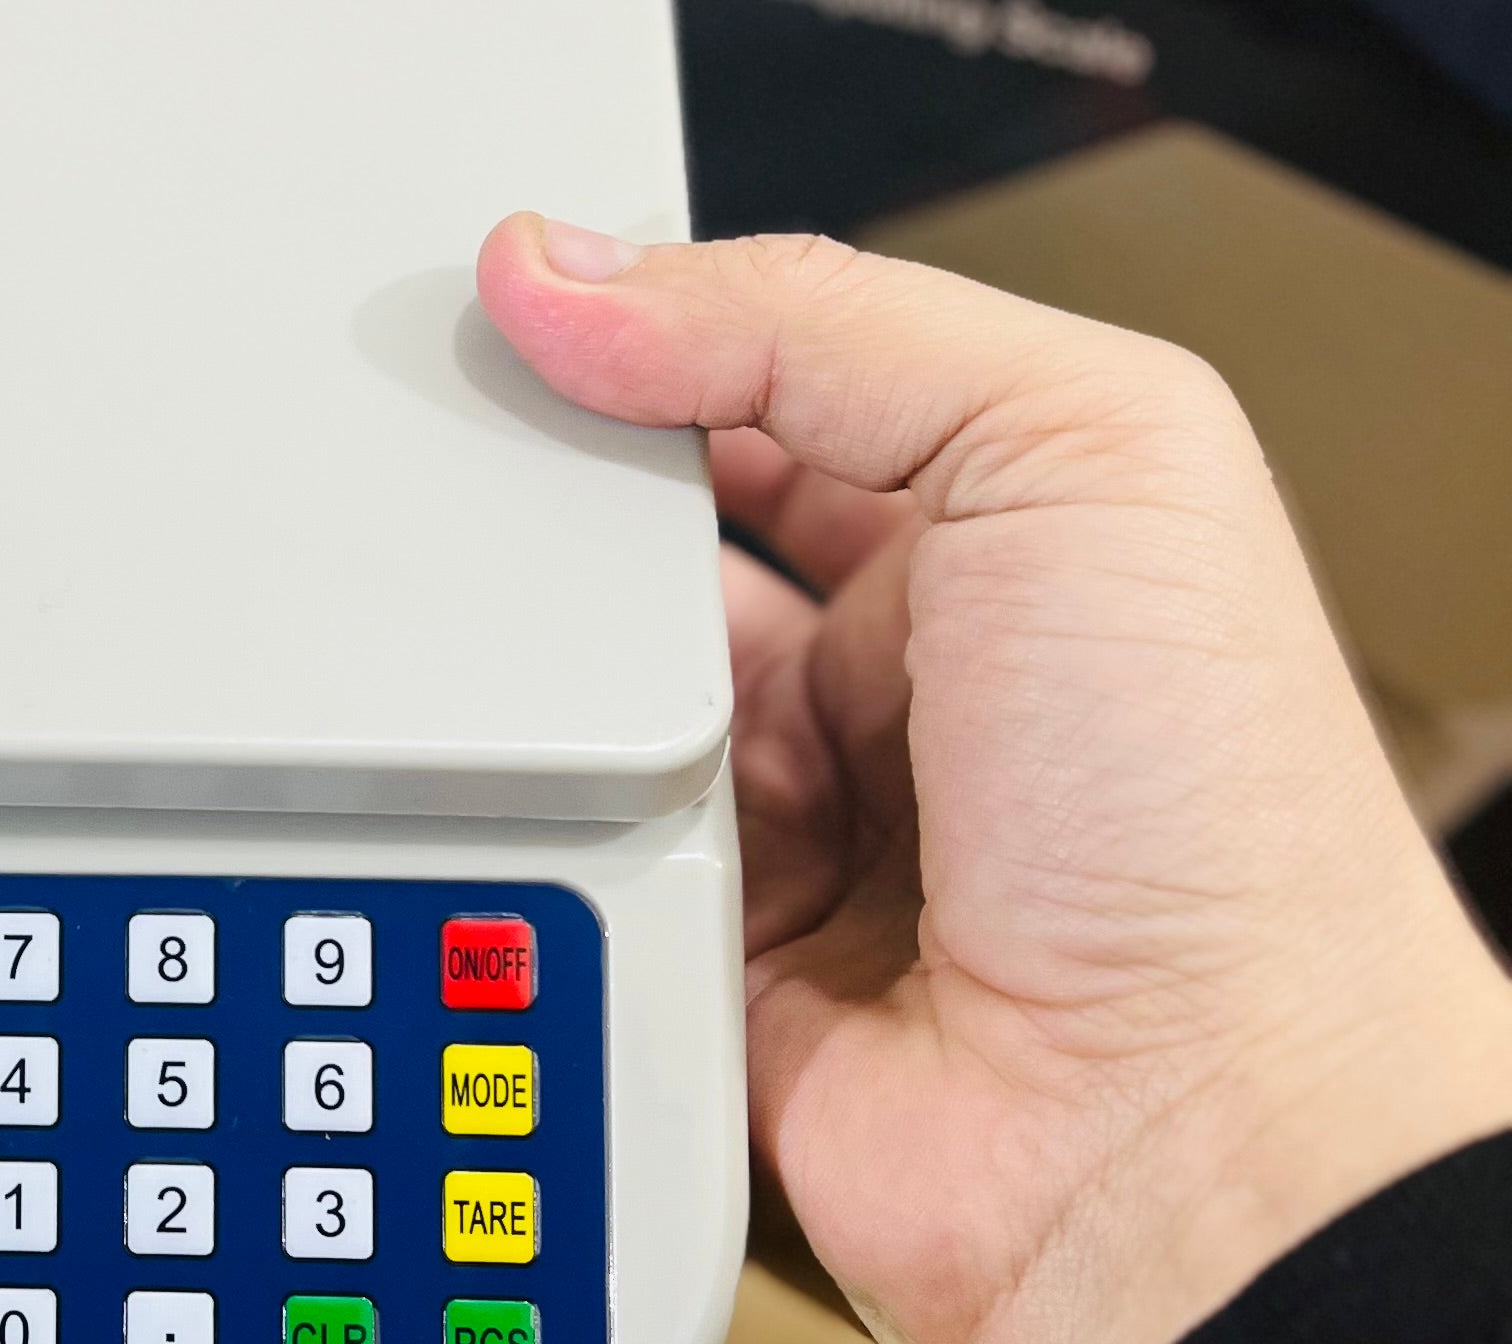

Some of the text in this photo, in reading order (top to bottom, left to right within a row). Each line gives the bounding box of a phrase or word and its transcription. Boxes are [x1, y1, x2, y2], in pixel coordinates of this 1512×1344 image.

[3, 934, 33, 980] 7
[157, 935, 188, 983] 8
[314, 938, 345, 985] 9
[447, 946, 528, 982] ON/OFF
[0, 1057, 32, 1104] 4
[157, 1060, 188, 1108] 5
[314, 1063, 345, 1111] 6
[451, 1072, 528, 1108] MODE
[3, 1183, 23, 1230] 1
[156, 1186, 187, 1234] 2
[315, 1189, 346, 1238] 3
[453, 1199, 527, 1237] TARE
